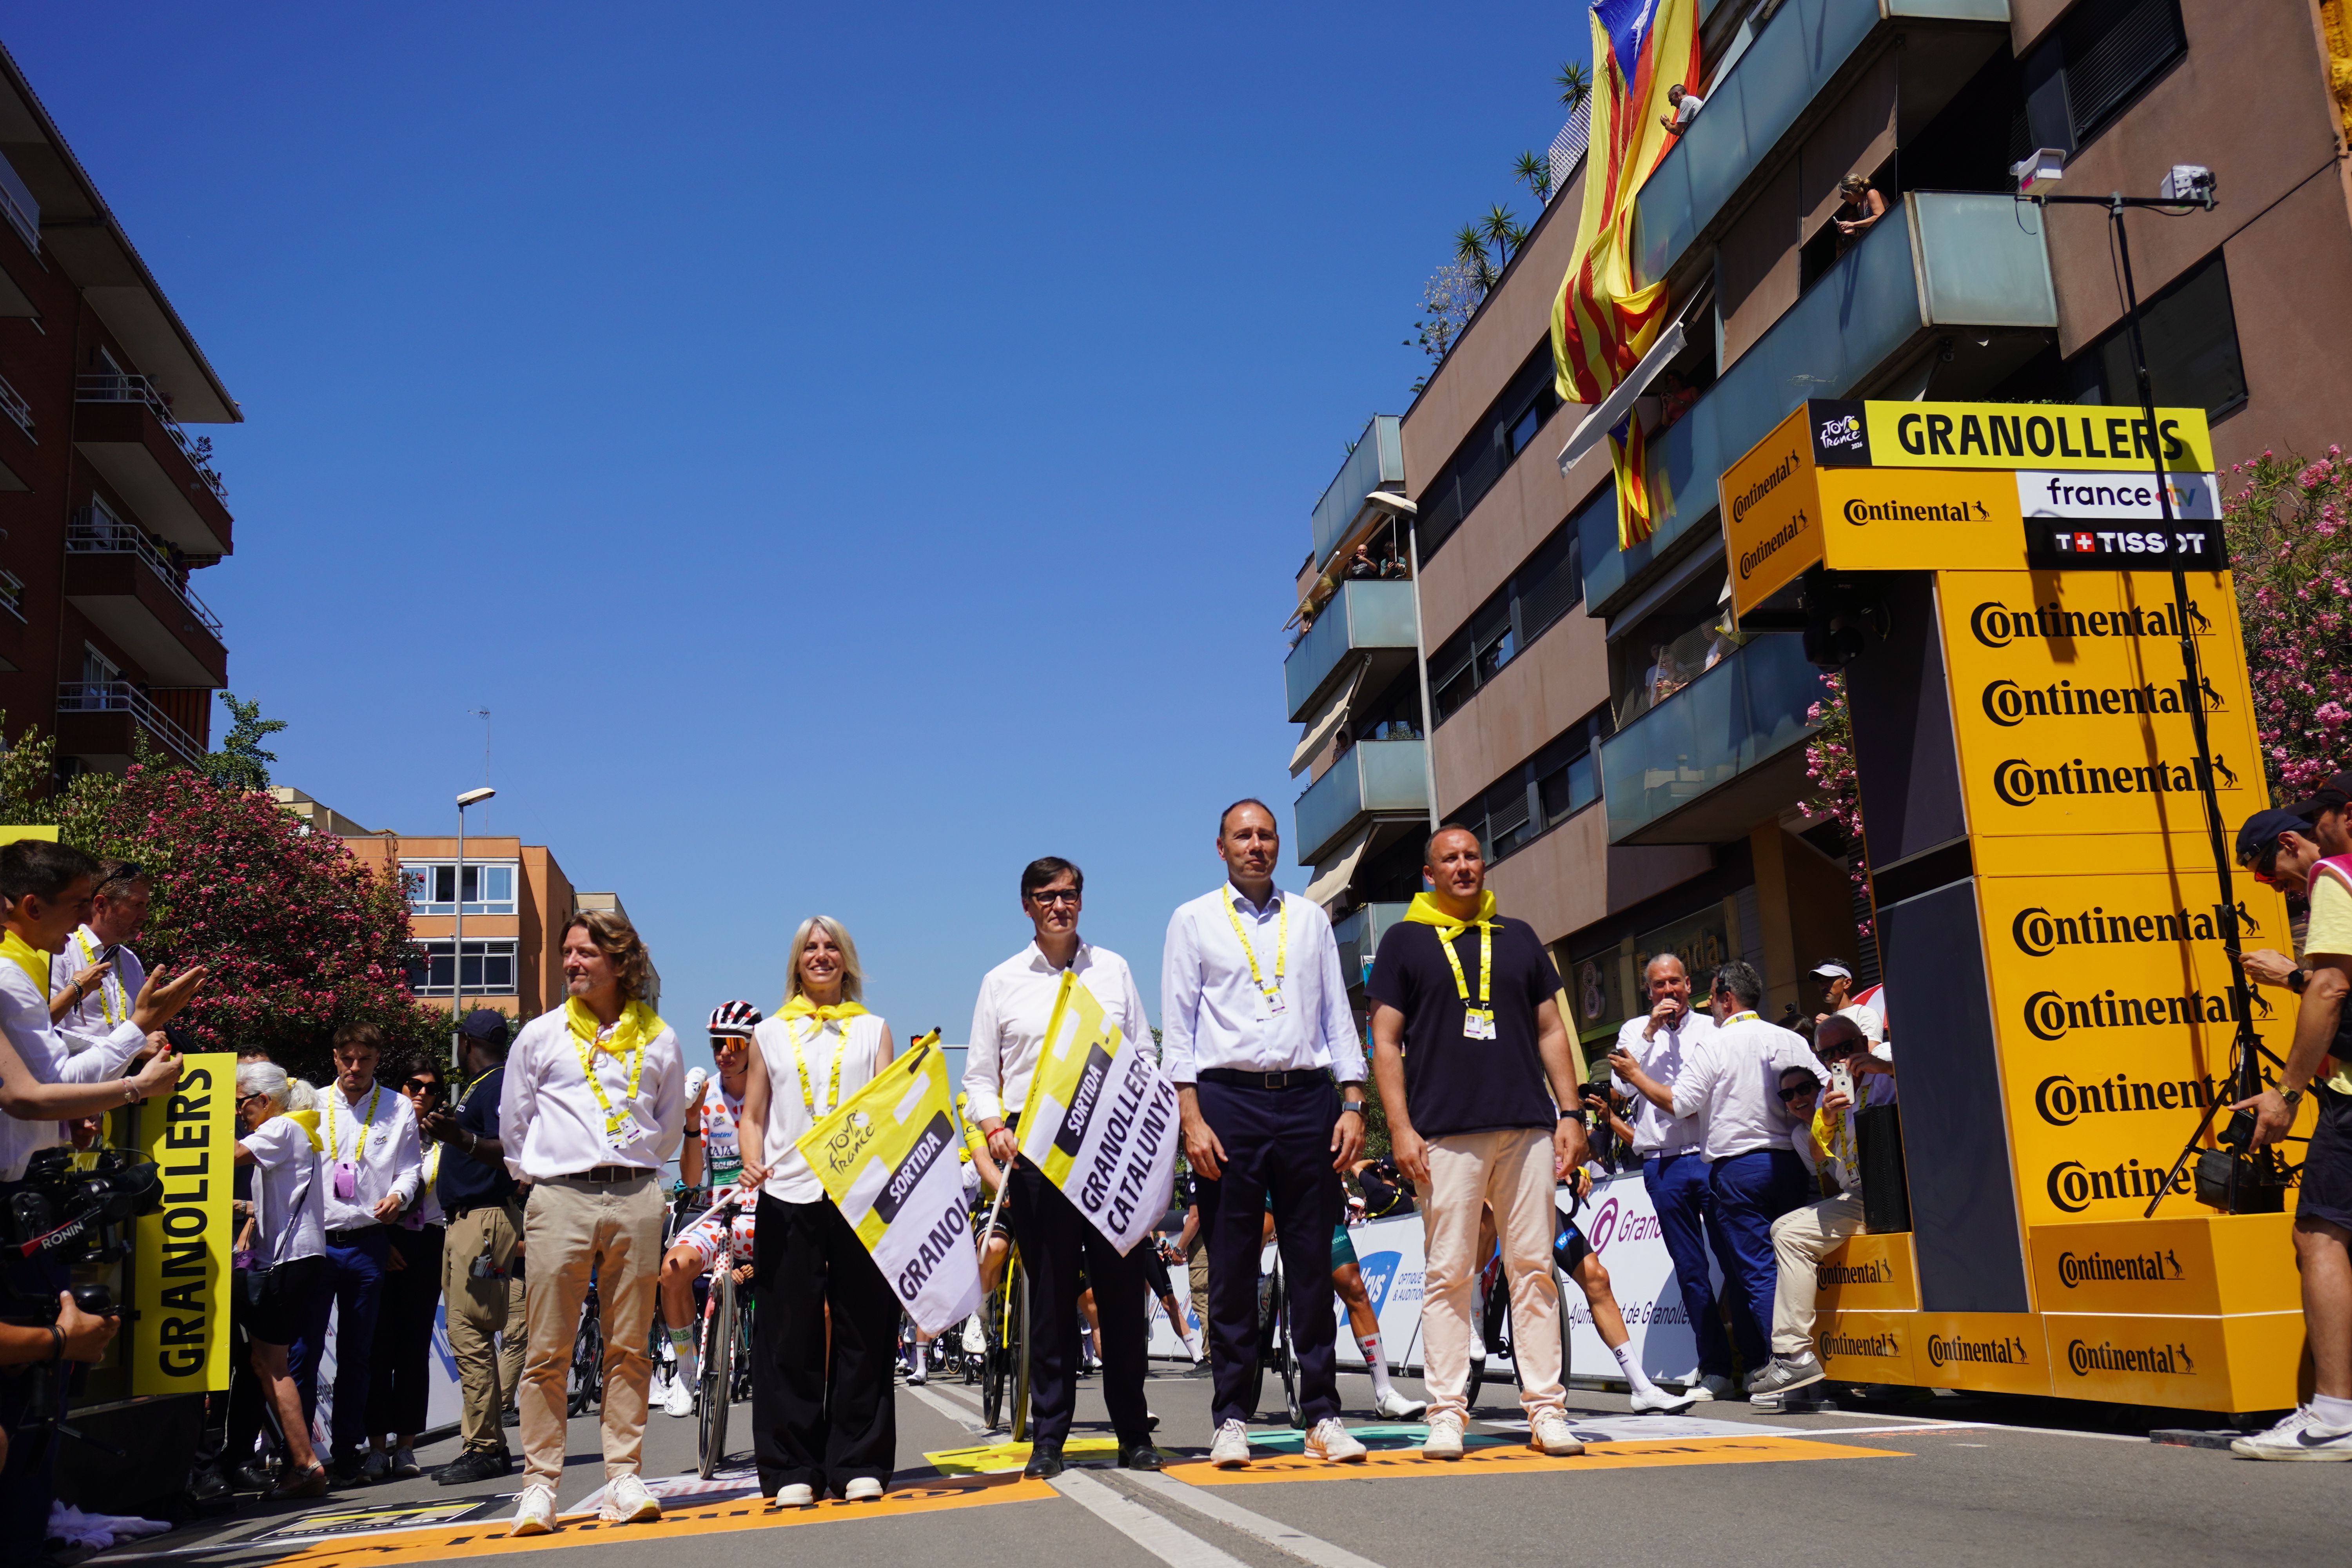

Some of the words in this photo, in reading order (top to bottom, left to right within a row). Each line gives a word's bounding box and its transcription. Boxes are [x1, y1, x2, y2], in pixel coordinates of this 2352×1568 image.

[1898, 413, 2183, 461] GRANOLLERS
[1733, 455, 1791, 523] Continental
[2046, 478, 2151, 506] france
[1844, 498, 1971, 526] Continental
[1740, 514, 1799, 580] Continental
[2096, 532, 2205, 554] TISSOT
[1971, 601, 2184, 648] Continental
[1982, 679, 2195, 727] Continental
[1994, 758, 2206, 807] Continental
[2012, 905, 2227, 956] Continental
[2024, 986, 2240, 1041] Continental
[1066, 1063, 1103, 1138] SORTIDA
[2035, 1073, 2236, 1127] Continenta
[889, 1131, 942, 1205] SORTIDA
[1107, 1079, 1175, 1236] CATALUNYA
[2047, 1158, 2197, 1213] Contine
[41, 1221, 84, 1250] RONIN
[158, 1068, 212, 1378] GRANOLLERS
[1618, 1210, 1662, 1242] Grano
[1398, 1272, 1424, 1285] OPTIQUE
[1816, 1259, 1882, 1291] Continental
[2058, 1251, 2166, 1289] Continental
[1392, 1290, 1398, 1301] &
[1626, 1301, 1640, 1324] de
[1642, 1301, 1691, 1325] Granolle
[1819, 1330, 1889, 1361] Continental
[1927, 1334, 2014, 1368] Continental
[2068, 1338, 2177, 1377] Continental
[276, 1523, 389, 1537] CENTURY
